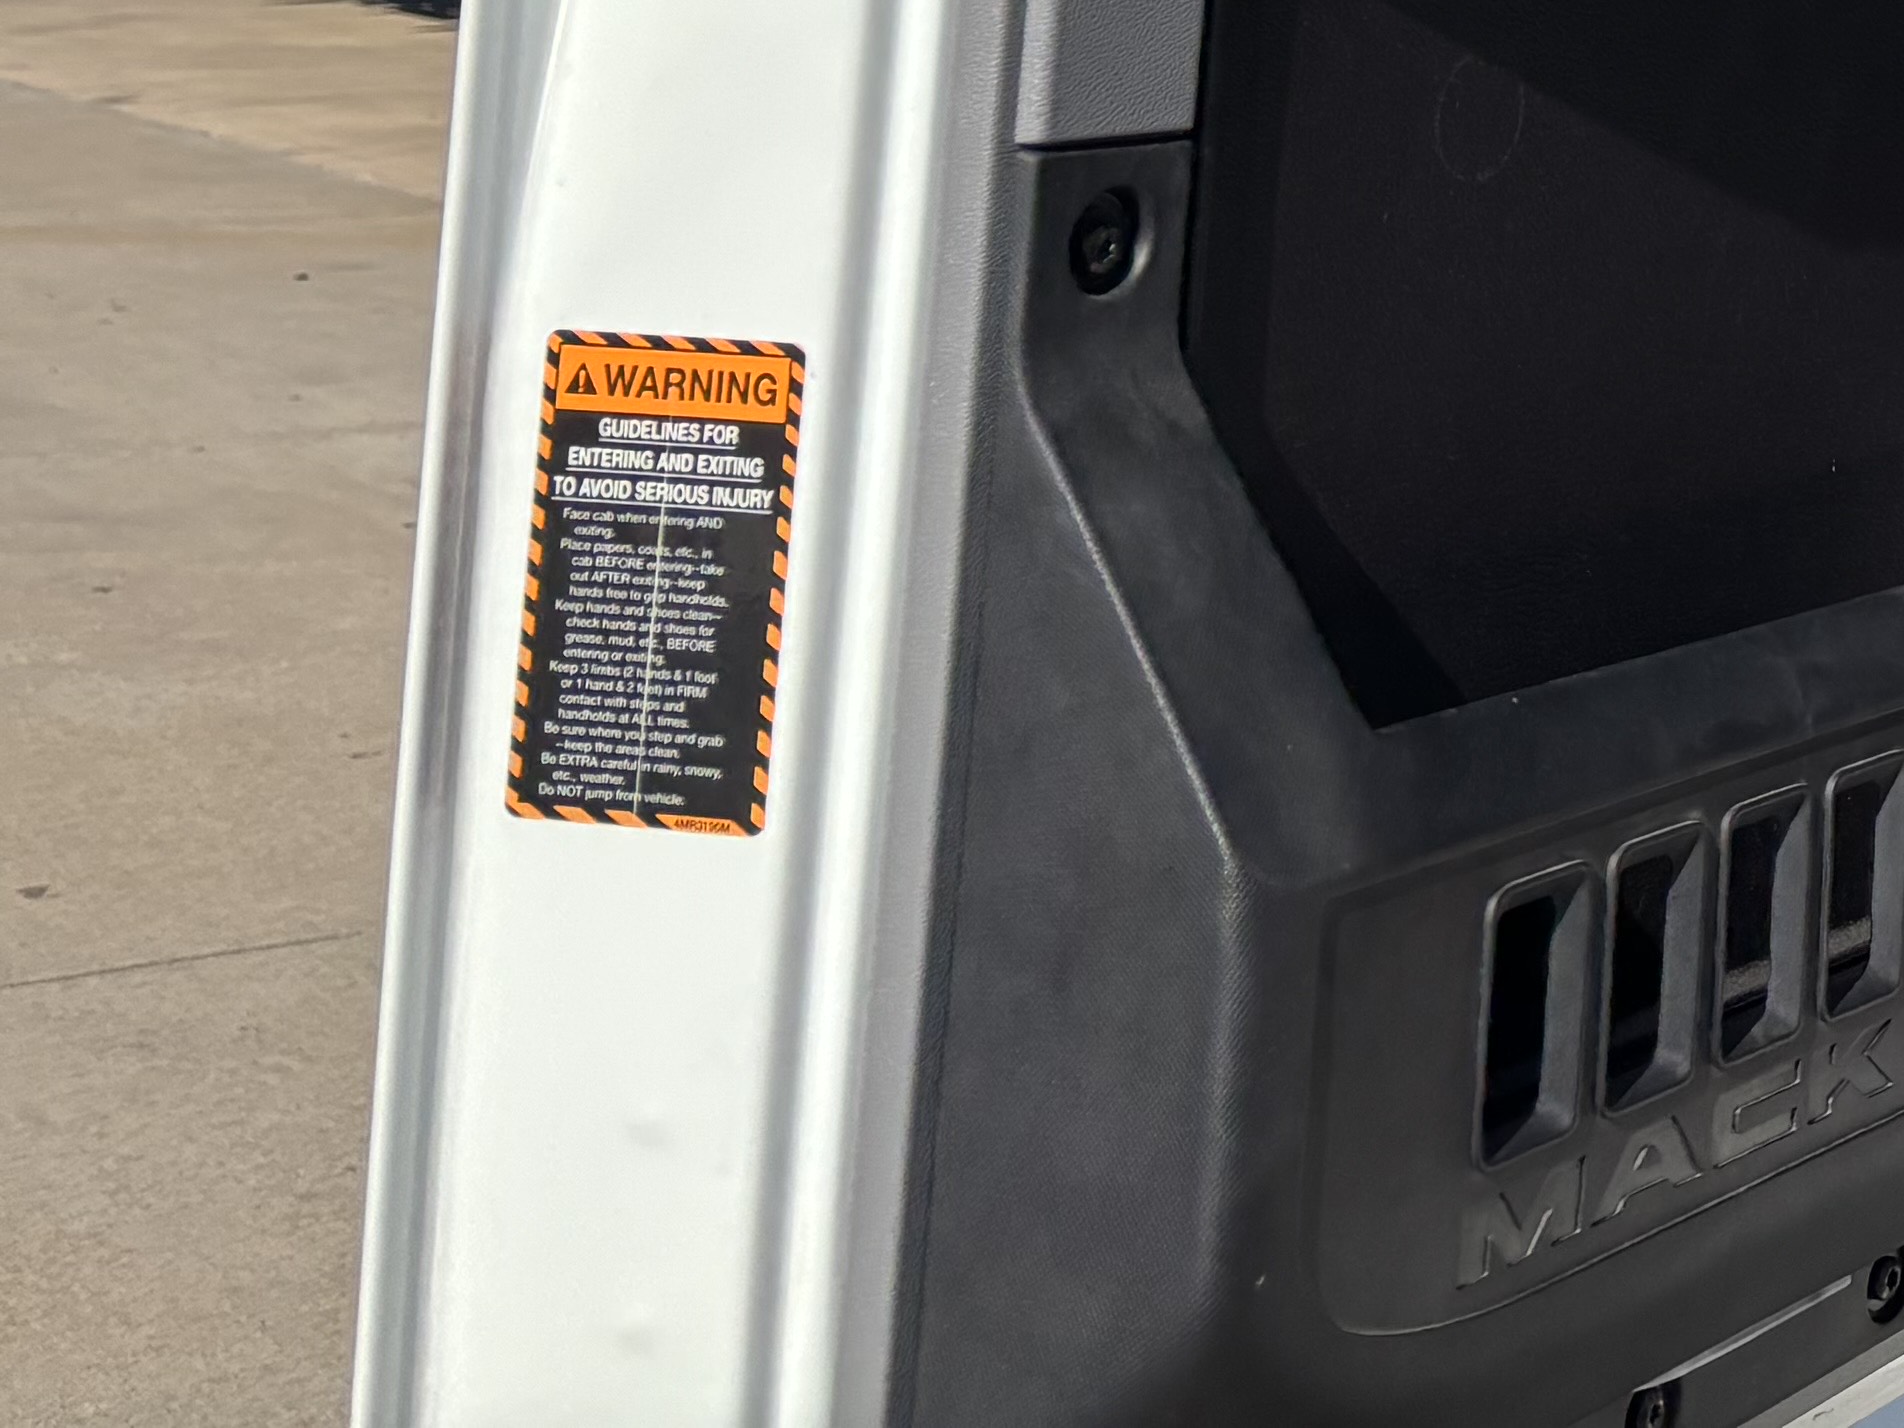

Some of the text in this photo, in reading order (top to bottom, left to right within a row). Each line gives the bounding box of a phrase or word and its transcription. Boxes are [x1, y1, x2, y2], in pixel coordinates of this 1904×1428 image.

[602, 362, 779, 407] WARNING
[597, 417, 740, 445] GUIDELINES FOR
[567, 445, 765, 478] ENTERING AND EXITING
[552, 475, 774, 509] TO AVOID SERIOUS INJURY
[562, 507, 723, 530] Face cab when entering AND
[559, 539, 590, 552] Place
[593, 542, 635, 556] papers,
[701, 548, 712, 560] in
[571, 554, 592, 567] cab
[594, 555, 644, 570] BEFORE
[569, 569, 588, 582] out
[591, 571, 630, 585] AFTER
[568, 585, 604, 599] hands
[605, 587, 628, 600] free
[629, 589, 641, 601] to
[643, 590, 666, 605] grip
[554, 599, 584, 614] Keep
[586, 601, 621, 615] hands
[623, 604, 644, 616] and
[646, 605, 680, 618] shoes
[565, 616, 714, 637] check hands and shoes for
[562, 647, 609, 662] entering
[610, 651, 623, 661] or
[666, 638, 715, 652] BEFORE
[548, 661, 578, 675] Keep
[580, 662, 588, 674] 3
[589, 663, 620, 676] limbs
[623, 665, 634, 677] (2
[636, 666, 672, 680] hands
[674, 668, 682, 680] &
[560, 679, 573, 689] or
[585, 679, 613, 692] hand
[614, 681, 624, 693] &
[625, 682, 634, 694] 2
[664, 685, 674, 696] in
[676, 685, 708, 698] FIRM
[558, 693, 685, 712] contact with steps and
[557, 708, 689, 728] handholds at ALL times.
[543, 722, 724, 748] Be sure where you step and grab
[594, 742, 612, 754] the
[615, 743, 646, 757] areas
[541, 752, 723, 780] Be EXTRA careful in rainy, snowy,
[579, 772, 626, 786] weather.
[538, 783, 555, 796] Do
[556, 785, 583, 798] NOT
[584, 787, 613, 802] jump
[615, 788, 641, 802] from
[1455, 1019, 1893, 1290] MACK
